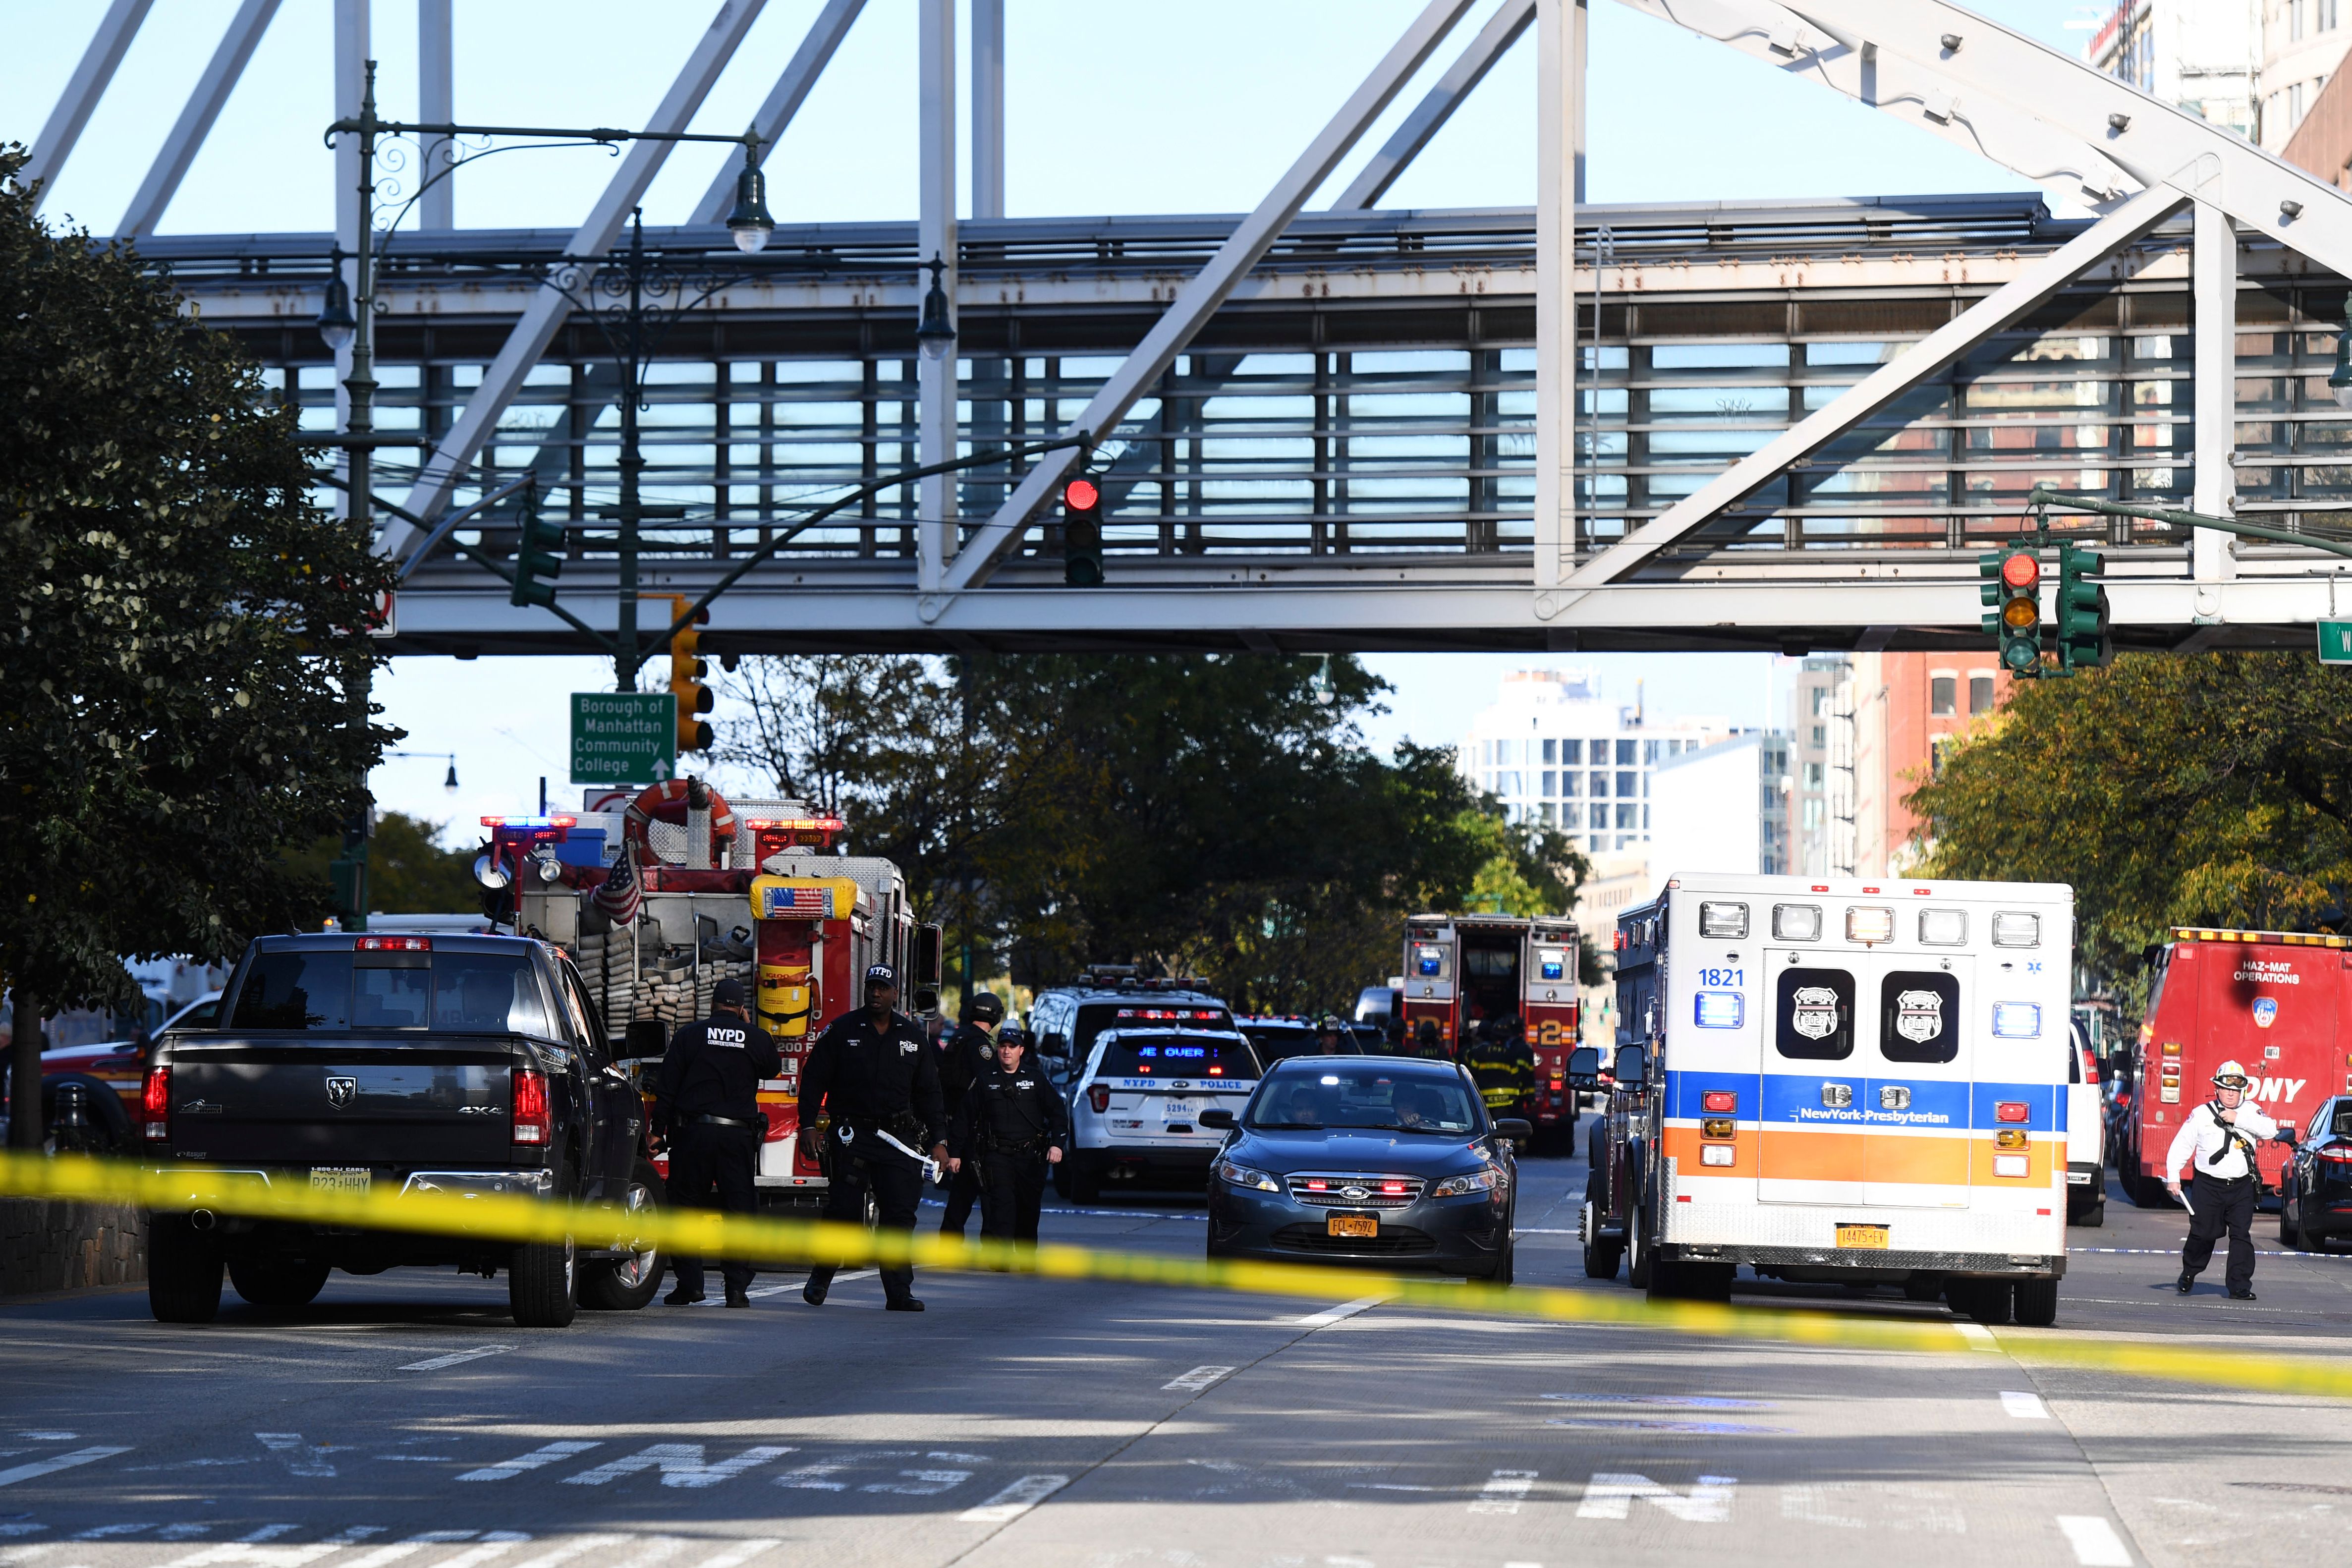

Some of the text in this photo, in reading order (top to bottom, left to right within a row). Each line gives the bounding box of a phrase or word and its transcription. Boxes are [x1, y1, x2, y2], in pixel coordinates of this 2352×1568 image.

[581, 698, 664, 718] Borough of
[585, 719, 662, 733] Manhattan
[575, 738, 660, 756] Community
[575, 757, 629, 776] College
[765, 888, 774, 914] KEEP
[823, 889, 832, 916] BACK
[869, 966, 892, 978] NYPD
[2243, 960, 2291, 973] HAZ-MAT
[1698, 969, 1743, 986] 1821
[2234, 971, 2300, 985] OPERATIONS
[708, 1027, 745, 1042] NYPD
[1540, 1019, 1561, 1046] 2
[777, 1043, 802, 1052] 200
[899, 1040, 918, 1050] POLICE
[1123, 1079, 1156, 1087] NYPD
[1200, 1080, 1242, 1089] POLICE
[2245, 1076, 2307, 1103] DNY
[1800, 1108, 1949, 1124] NewYork-Presbyterian
[1333, 1220, 1372, 1232] FCL 7592
[1842, 1230, 1884, 1243] 14475 EV
